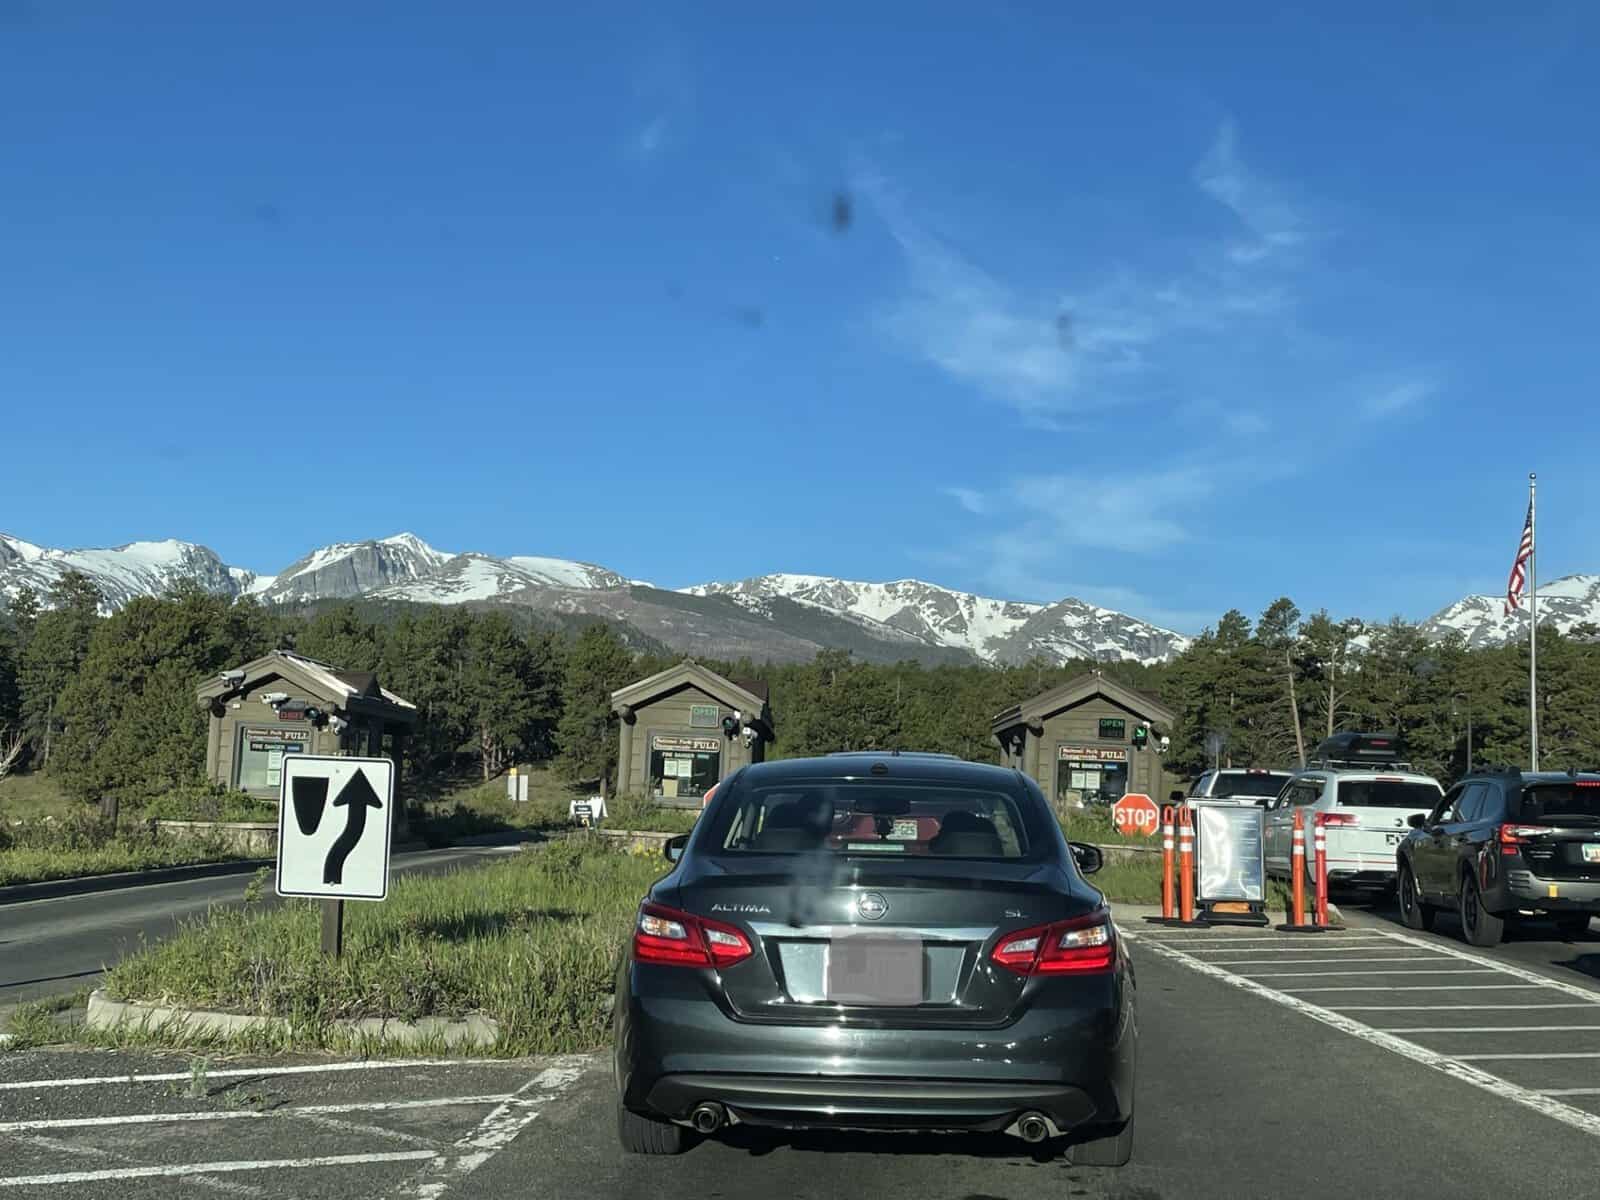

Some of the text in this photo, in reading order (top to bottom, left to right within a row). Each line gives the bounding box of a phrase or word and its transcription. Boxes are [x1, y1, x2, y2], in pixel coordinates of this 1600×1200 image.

[1101, 719, 1124, 728] OPEN
[285, 731, 308, 740] FULL
[693, 741, 718, 749] FULL
[1115, 807, 1156, 826] STOP
[711, 904, 771, 913] ALTIMA
